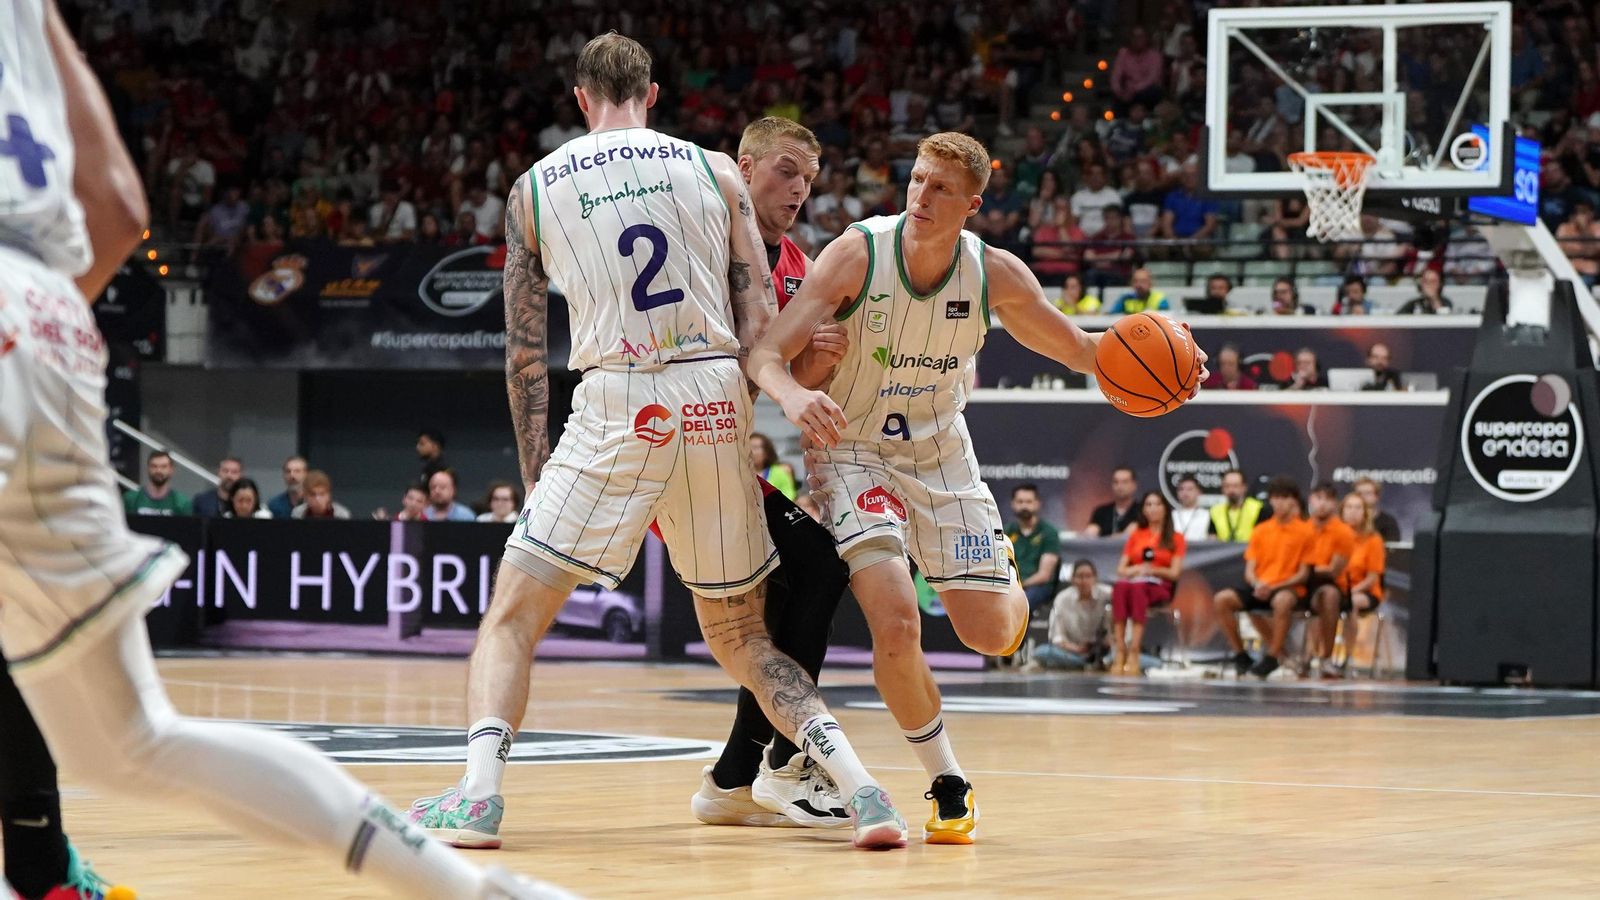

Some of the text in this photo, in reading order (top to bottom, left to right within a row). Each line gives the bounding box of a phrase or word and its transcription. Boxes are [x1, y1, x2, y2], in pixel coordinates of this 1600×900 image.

[542, 142, 693, 188] Balcerowski
[617, 223, 685, 312] 2
[890, 353, 959, 374] Unicaja
[681, 401, 737, 418] COSTA
[683, 418, 738, 432] DEL SOL
[882, 413, 910, 441] 9
[1475, 421, 1569, 438] supercopa
[684, 432, 738, 446] MÁLAGA
[1482, 437, 1569, 457] endesa
[954, 543, 992, 564] laga
[807, 724, 836, 759] UNICAJA
